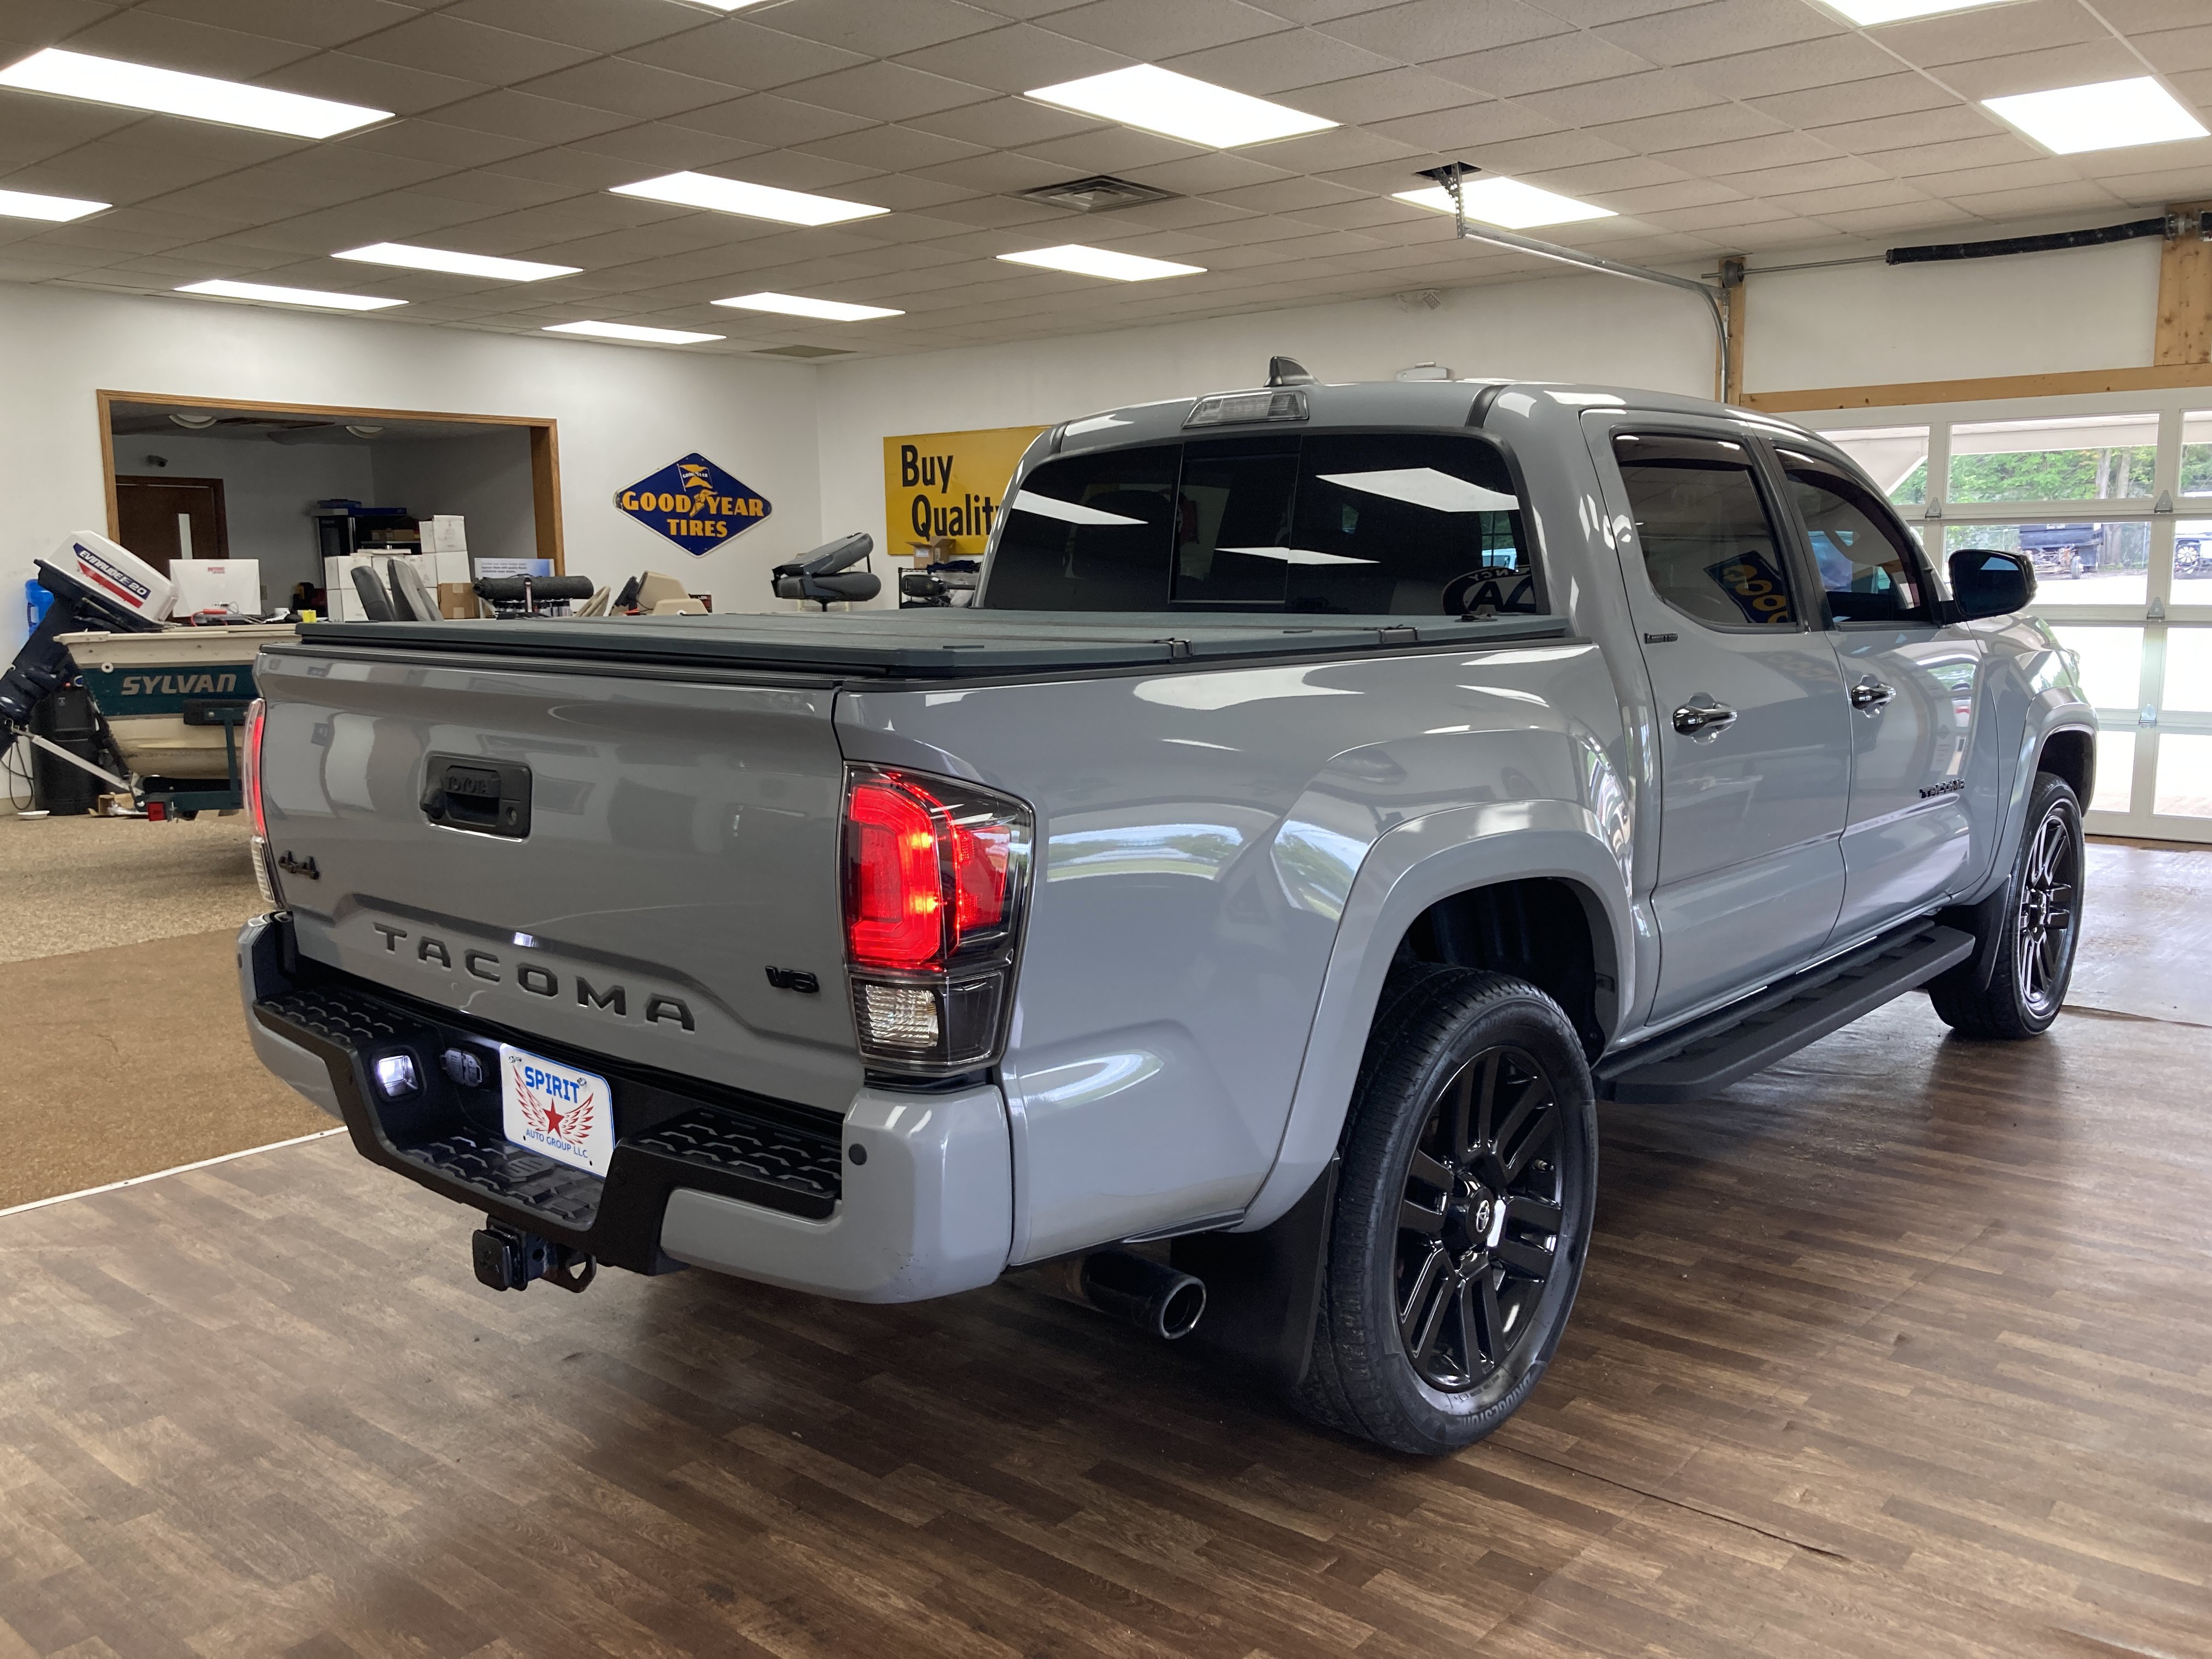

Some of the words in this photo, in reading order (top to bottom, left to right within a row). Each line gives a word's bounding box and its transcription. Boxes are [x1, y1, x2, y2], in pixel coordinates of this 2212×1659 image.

[901, 445, 954, 494] Buy
[667, 518, 727, 538] TIRES
[911, 493, 1000, 542] Qualit
[121, 674, 237, 696] SYLVAN
[445, 775, 492, 795] TOYOTA
[373, 922, 695, 1035] TACOMA
[765, 966, 820, 993] V6
[524, 1066, 580, 1104] SPIRIT
[526, 1128, 544, 1142] AUTO
[546, 1136, 571, 1152] GROUP
[573, 1147, 588, 1159] LLC
